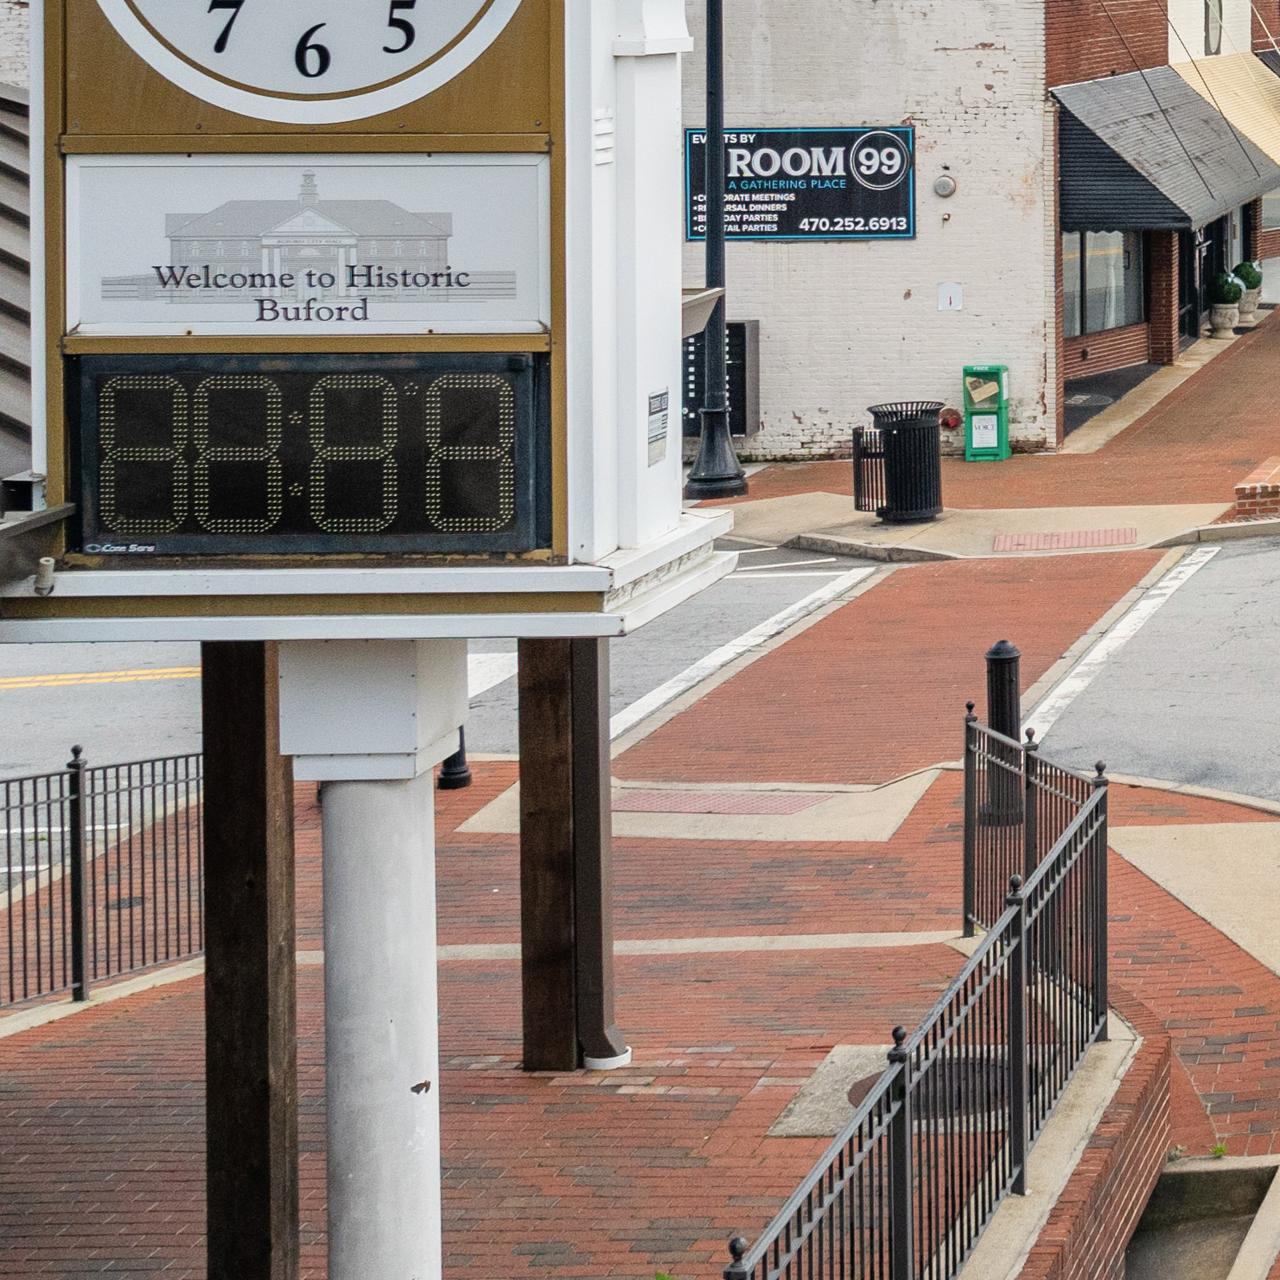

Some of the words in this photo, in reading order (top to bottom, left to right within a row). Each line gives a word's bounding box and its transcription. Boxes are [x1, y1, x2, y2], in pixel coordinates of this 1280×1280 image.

[295, 22, 331, 78] 6
[692, 134, 737, 144] EVTS
[740, 134, 756, 144] BY
[727, 147, 847, 177] ROOM
[858, 147, 902, 176] 99
[728, 181, 737, 190] A
[740, 180, 807, 190] GATHERING
[810, 179, 847, 189] PLACE
[751, 193, 796, 201] MEETINGS
[742, 224, 777, 232] PARTIES
[798, 217, 907, 232] 470.252.6913
[152, 264, 294, 289] Welcome
[305, 267, 336, 288] to
[345, 265, 471, 288] Historic
[254, 297, 369, 322] Buford
